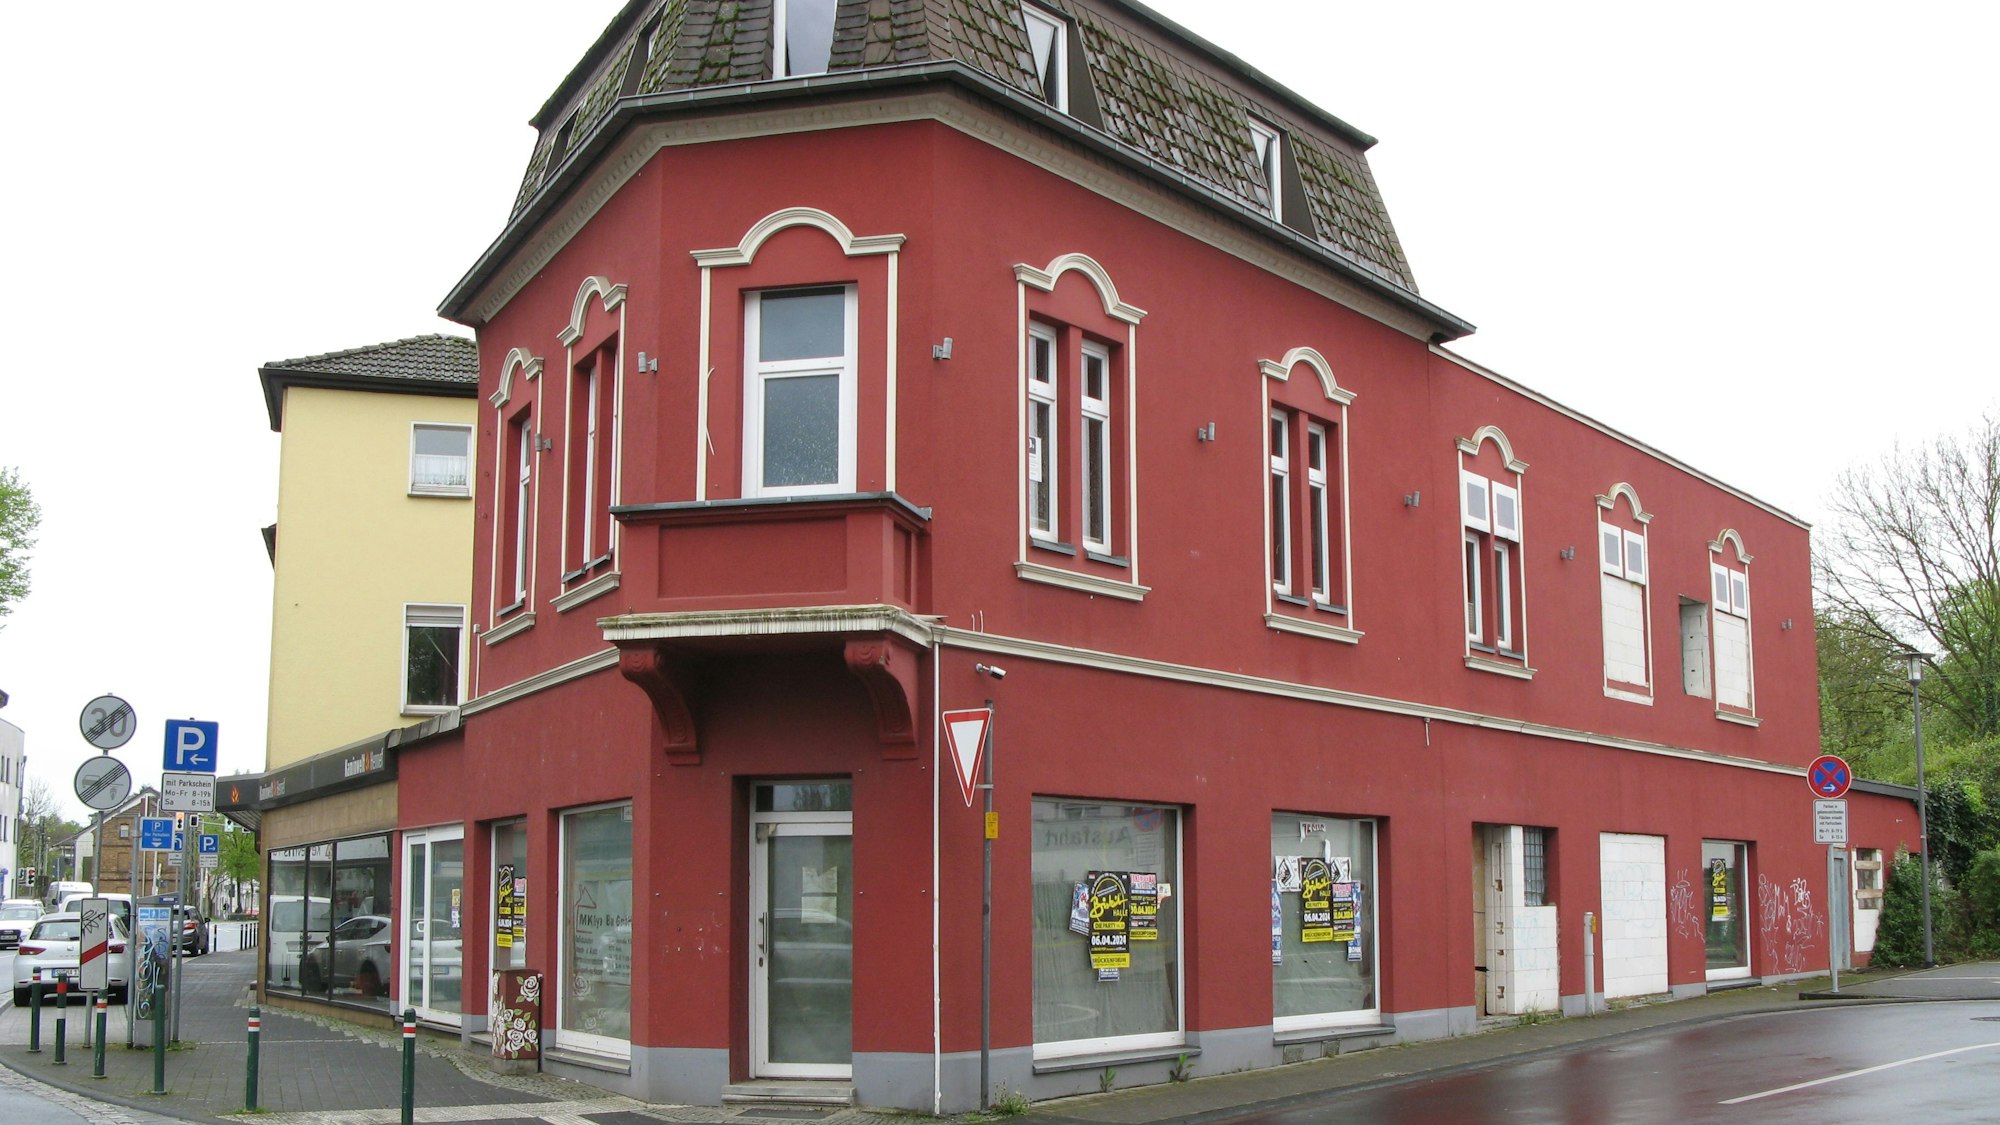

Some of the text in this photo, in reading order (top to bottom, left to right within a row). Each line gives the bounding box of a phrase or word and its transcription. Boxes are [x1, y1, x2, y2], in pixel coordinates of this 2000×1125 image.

[90, 707, 128, 738] 30
[176, 726, 206, 765] P
[178, 779, 212, 787] Parkschein
[165, 789, 188, 797] Mo-Fr
[154, 822, 161, 830] P
[203, 836, 215, 851] P
[1091, 935, 1127, 946] 06.04.2024
